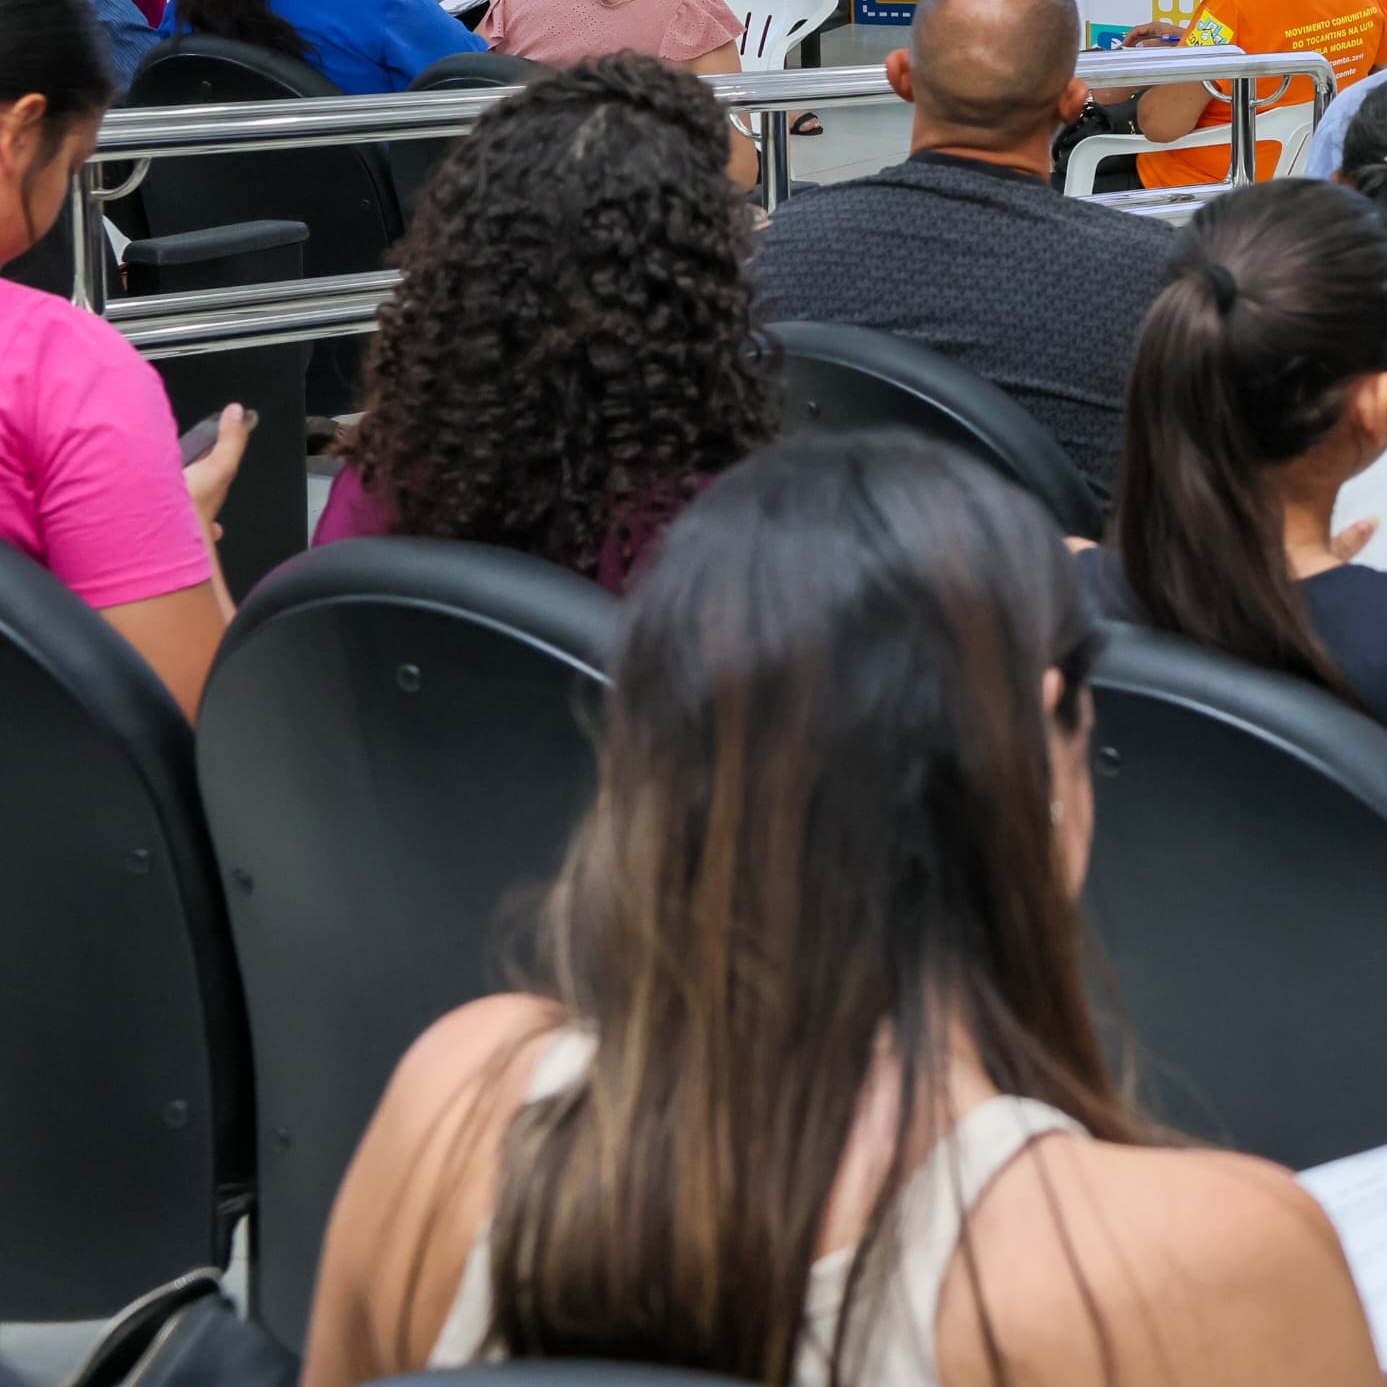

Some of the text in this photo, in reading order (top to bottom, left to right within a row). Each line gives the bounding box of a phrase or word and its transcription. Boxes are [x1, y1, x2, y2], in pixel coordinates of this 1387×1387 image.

[1285, 20, 1330, 38] MOVIMENTO
[1292, 21, 1374, 49] DO TOCANTINS NA LUTA
[1330, 38, 1363, 52] MORADIA
